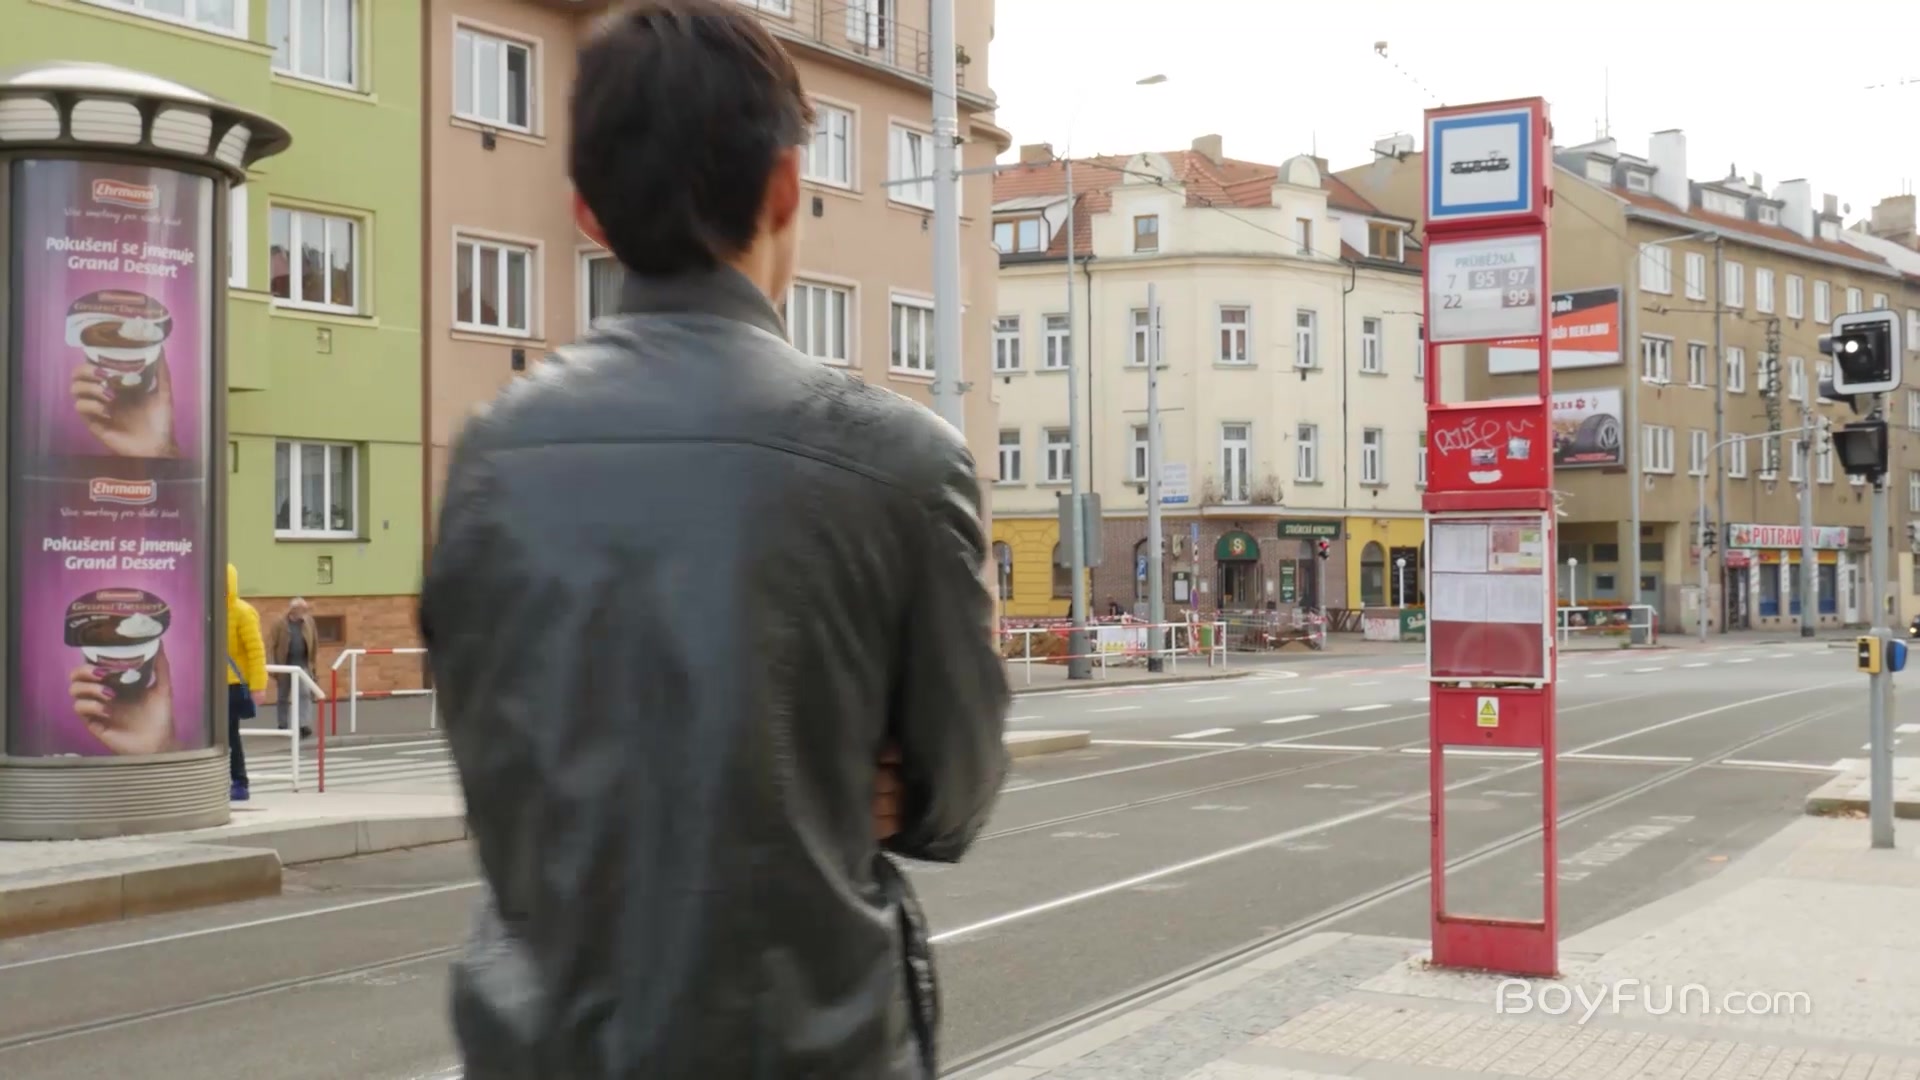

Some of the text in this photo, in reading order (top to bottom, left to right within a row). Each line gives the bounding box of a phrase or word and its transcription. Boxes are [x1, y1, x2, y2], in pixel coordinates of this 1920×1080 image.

[95, 184, 154, 199] Ehrmann
[46, 237, 195, 265] Pokušení se jmenuje
[1455, 252, 1517, 267] PRŮBĚŽNÁ
[68, 256, 178, 279] Grand Dessert
[1447, 268, 1529, 289] 7 95 97
[1443, 290, 1530, 309] 22 99
[93, 482, 152, 496] Ehrmann
[1752, 527, 1821, 546] POTRAVY
[42, 537, 192, 556] Pokušení se jmenuje
[64, 556, 176, 571] Grand Dessert
